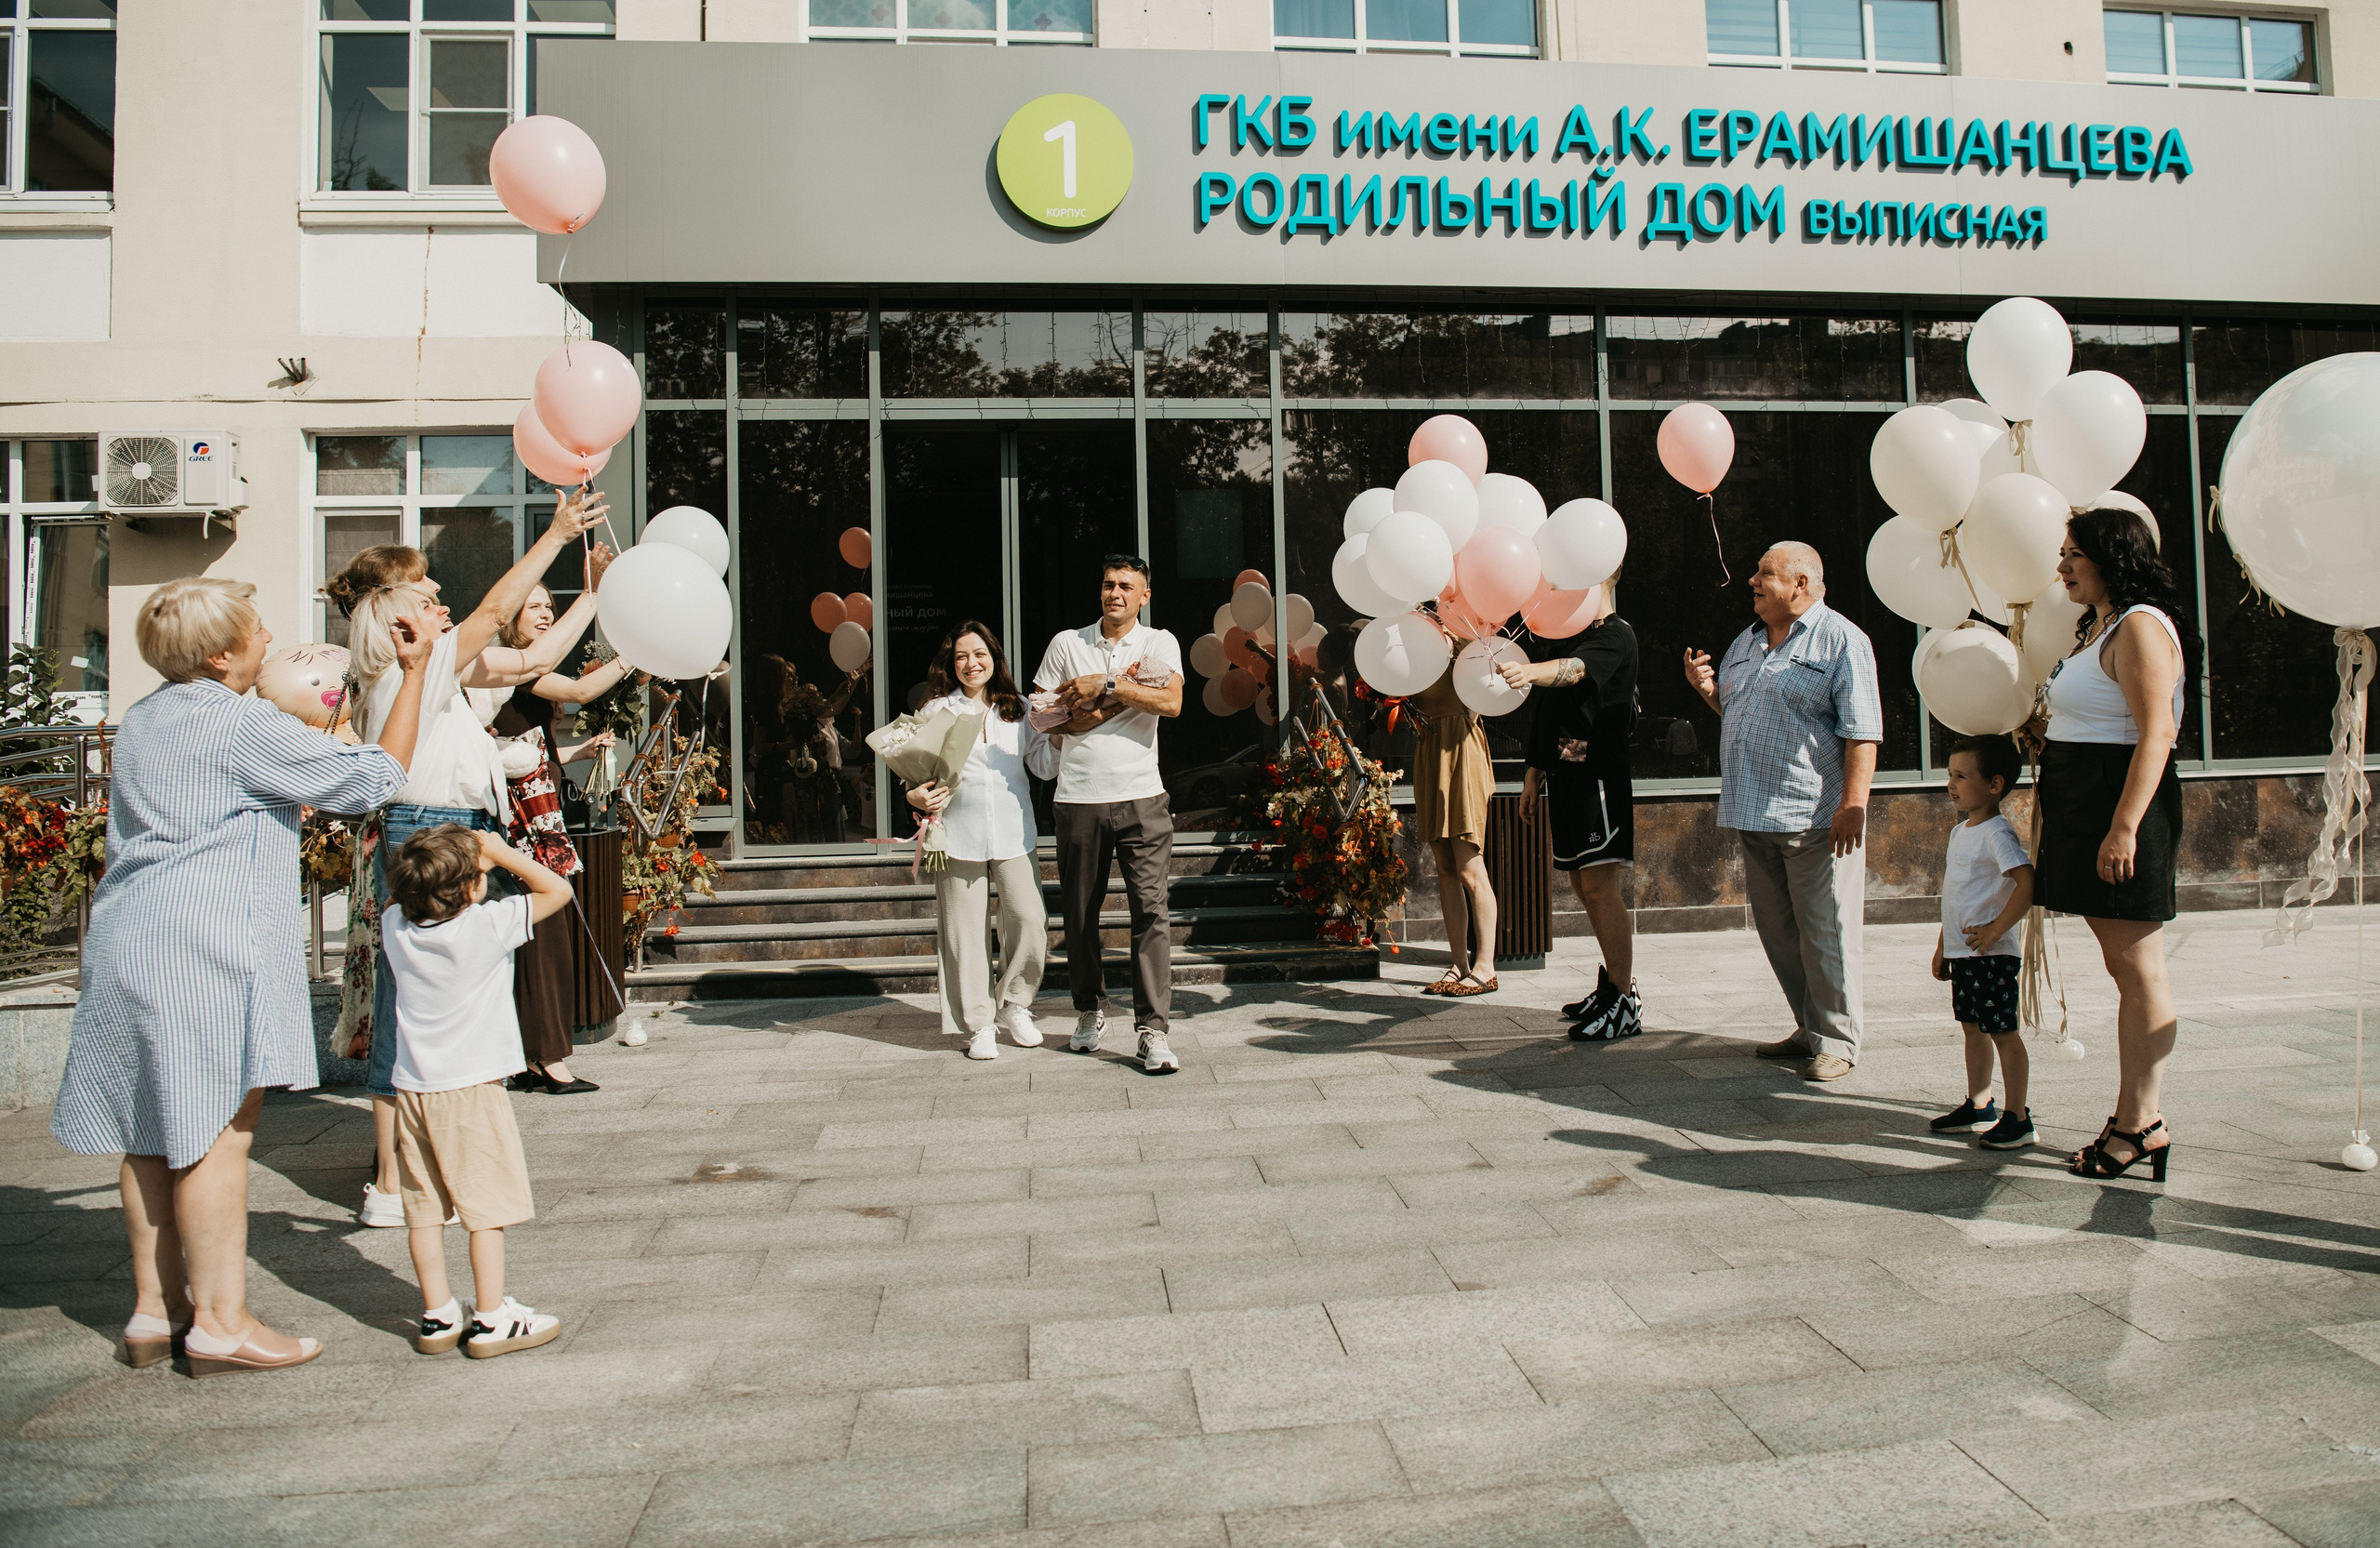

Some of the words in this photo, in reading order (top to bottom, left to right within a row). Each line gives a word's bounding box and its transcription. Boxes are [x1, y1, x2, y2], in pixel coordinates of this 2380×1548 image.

[1043, 120, 1077, 198] 1
[1197, 93, 1317, 147] ГКБ
[1340, 110, 1540, 154] имени
[1559, 104, 1672, 157] А.К.
[1689, 108, 2194, 180] ЕРАМИШАНЦЕВА
[1046, 207, 1088, 218] КОРПУС
[1199, 165, 1627, 235] РОДИЛЬНЫЙ
[1646, 181, 1786, 242] ДОМ
[1808, 199, 2048, 242] ВЫПИСНАЯ
